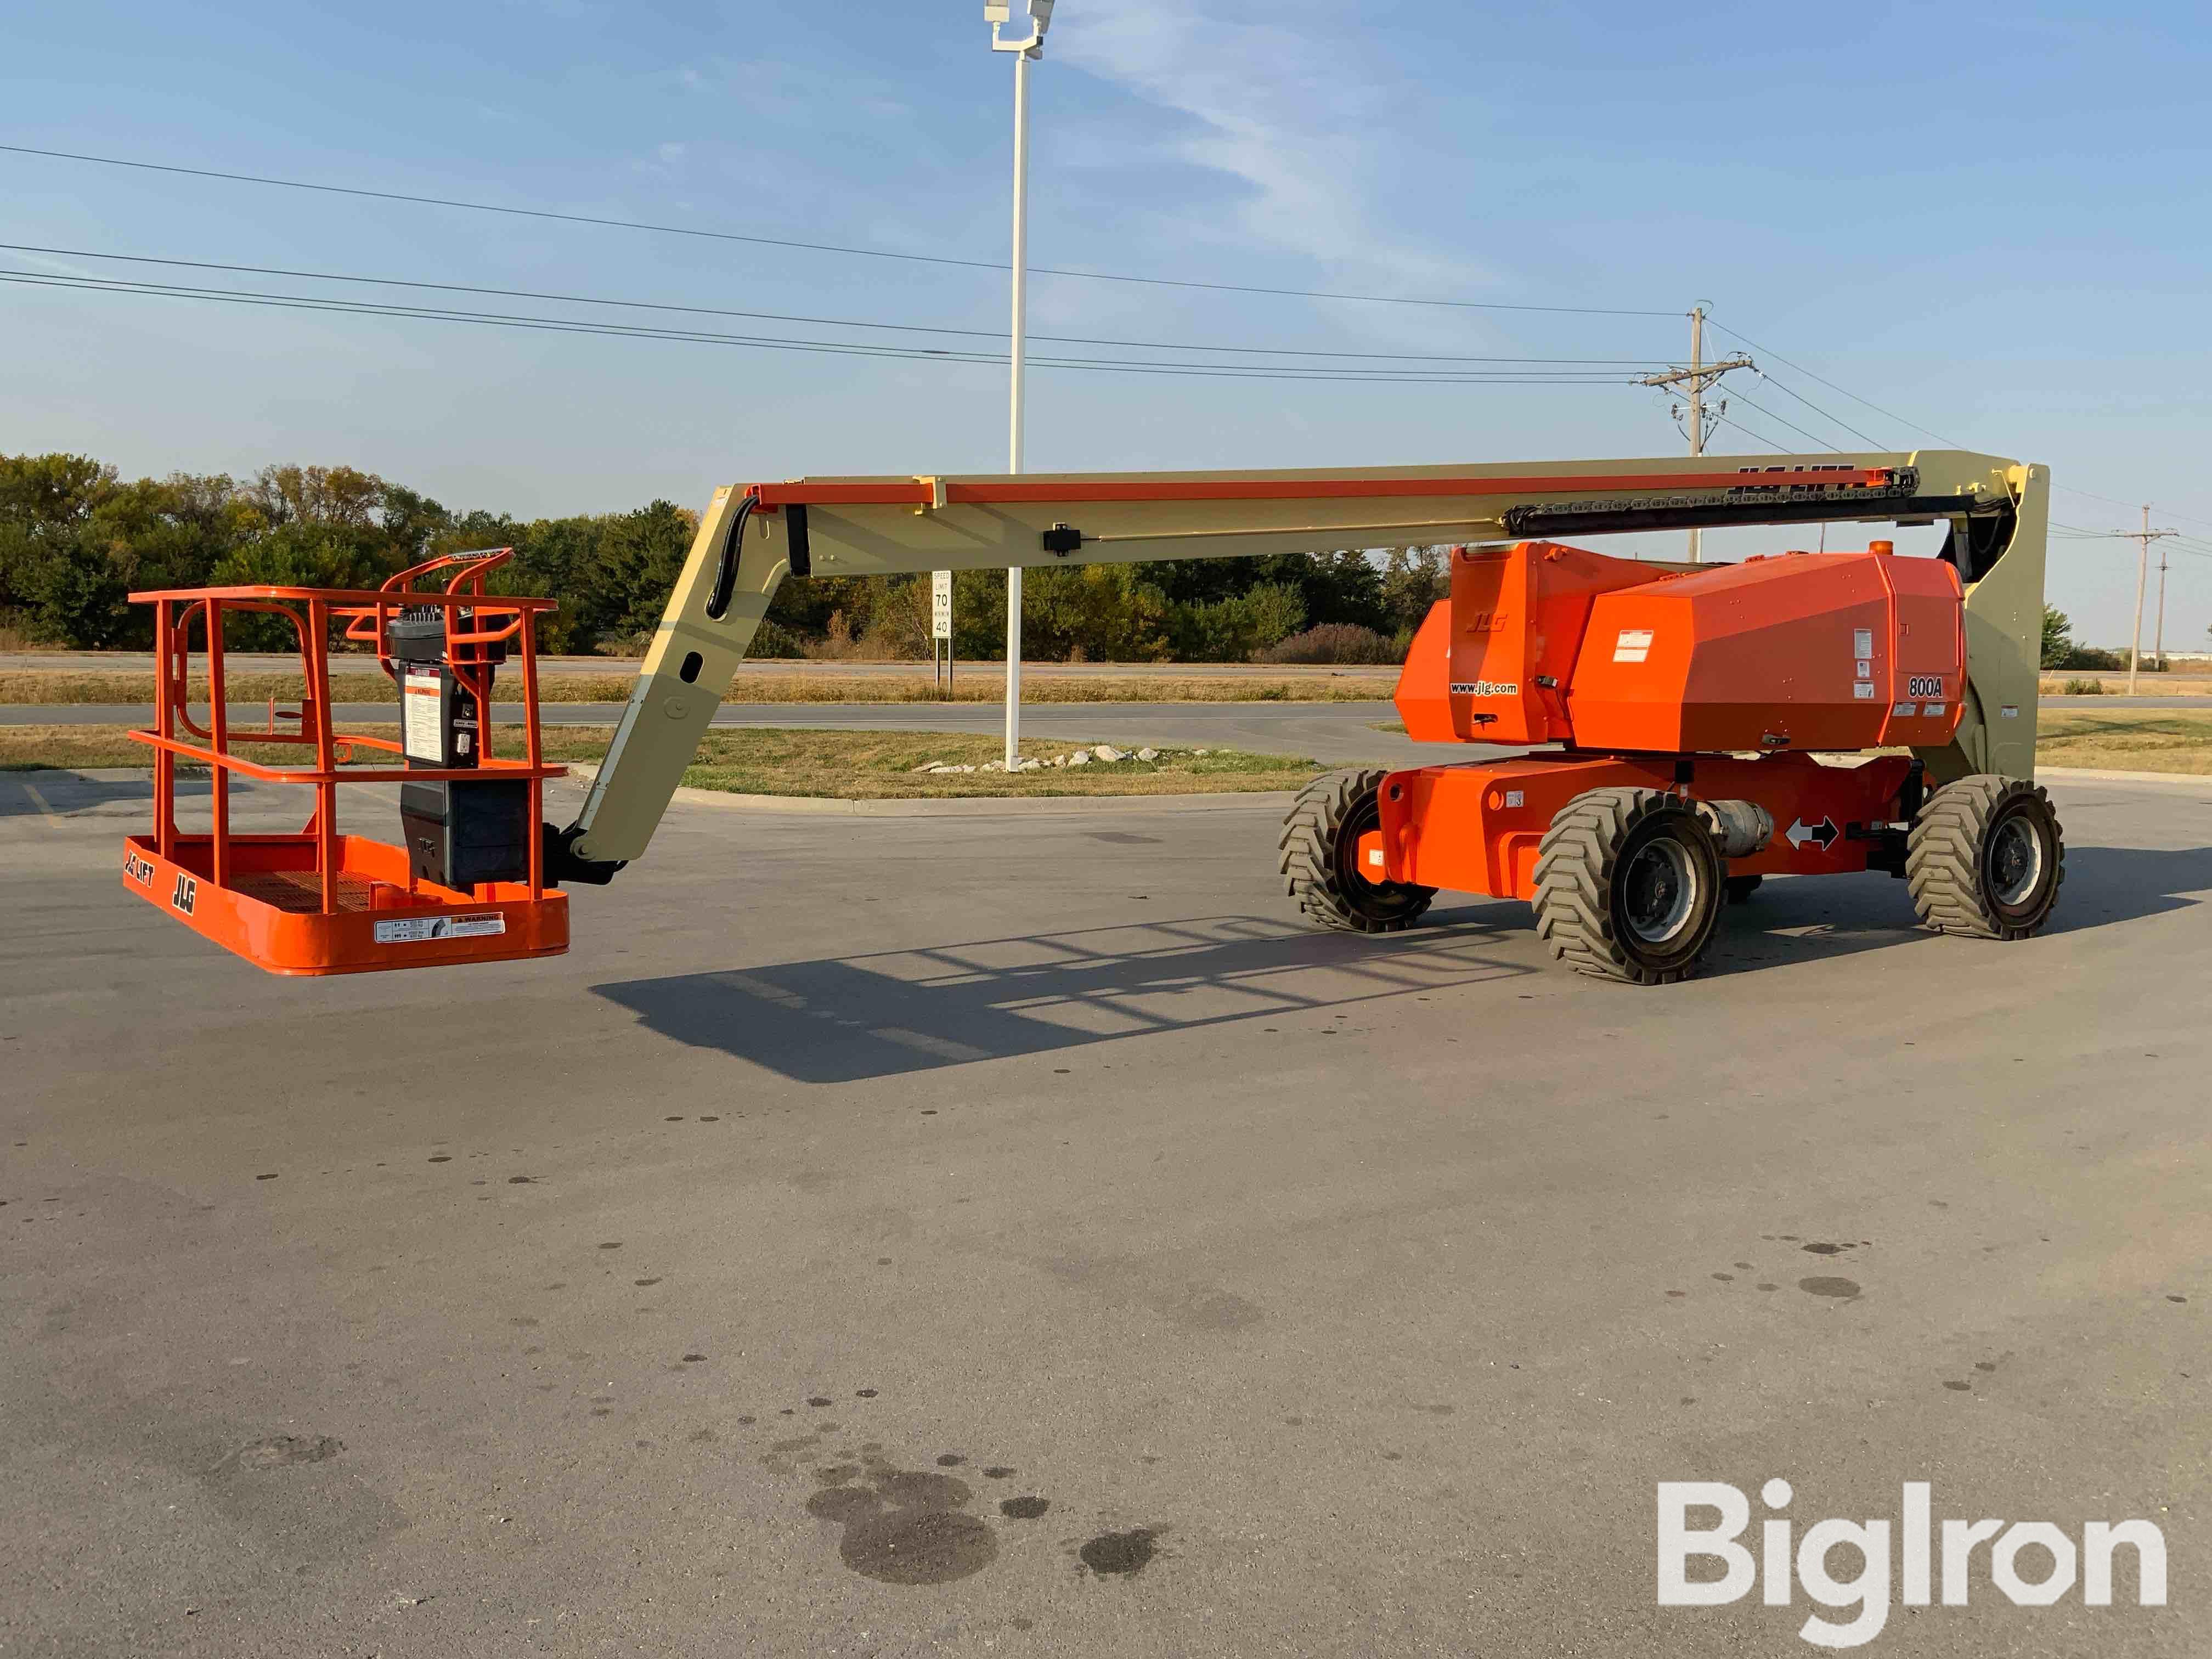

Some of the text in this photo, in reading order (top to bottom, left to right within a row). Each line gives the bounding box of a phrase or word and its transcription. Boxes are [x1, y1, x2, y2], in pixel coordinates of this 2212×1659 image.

[935, 594, 947, 606] 70
[936, 622, 947, 632] 40
[1466, 613, 1508, 633] JLG
[1451, 681, 1516, 695] www.jlg.com
[1909, 677, 1943, 697] 800A
[136, 859, 154, 887] LIFT
[173, 873, 196, 915] JLG
